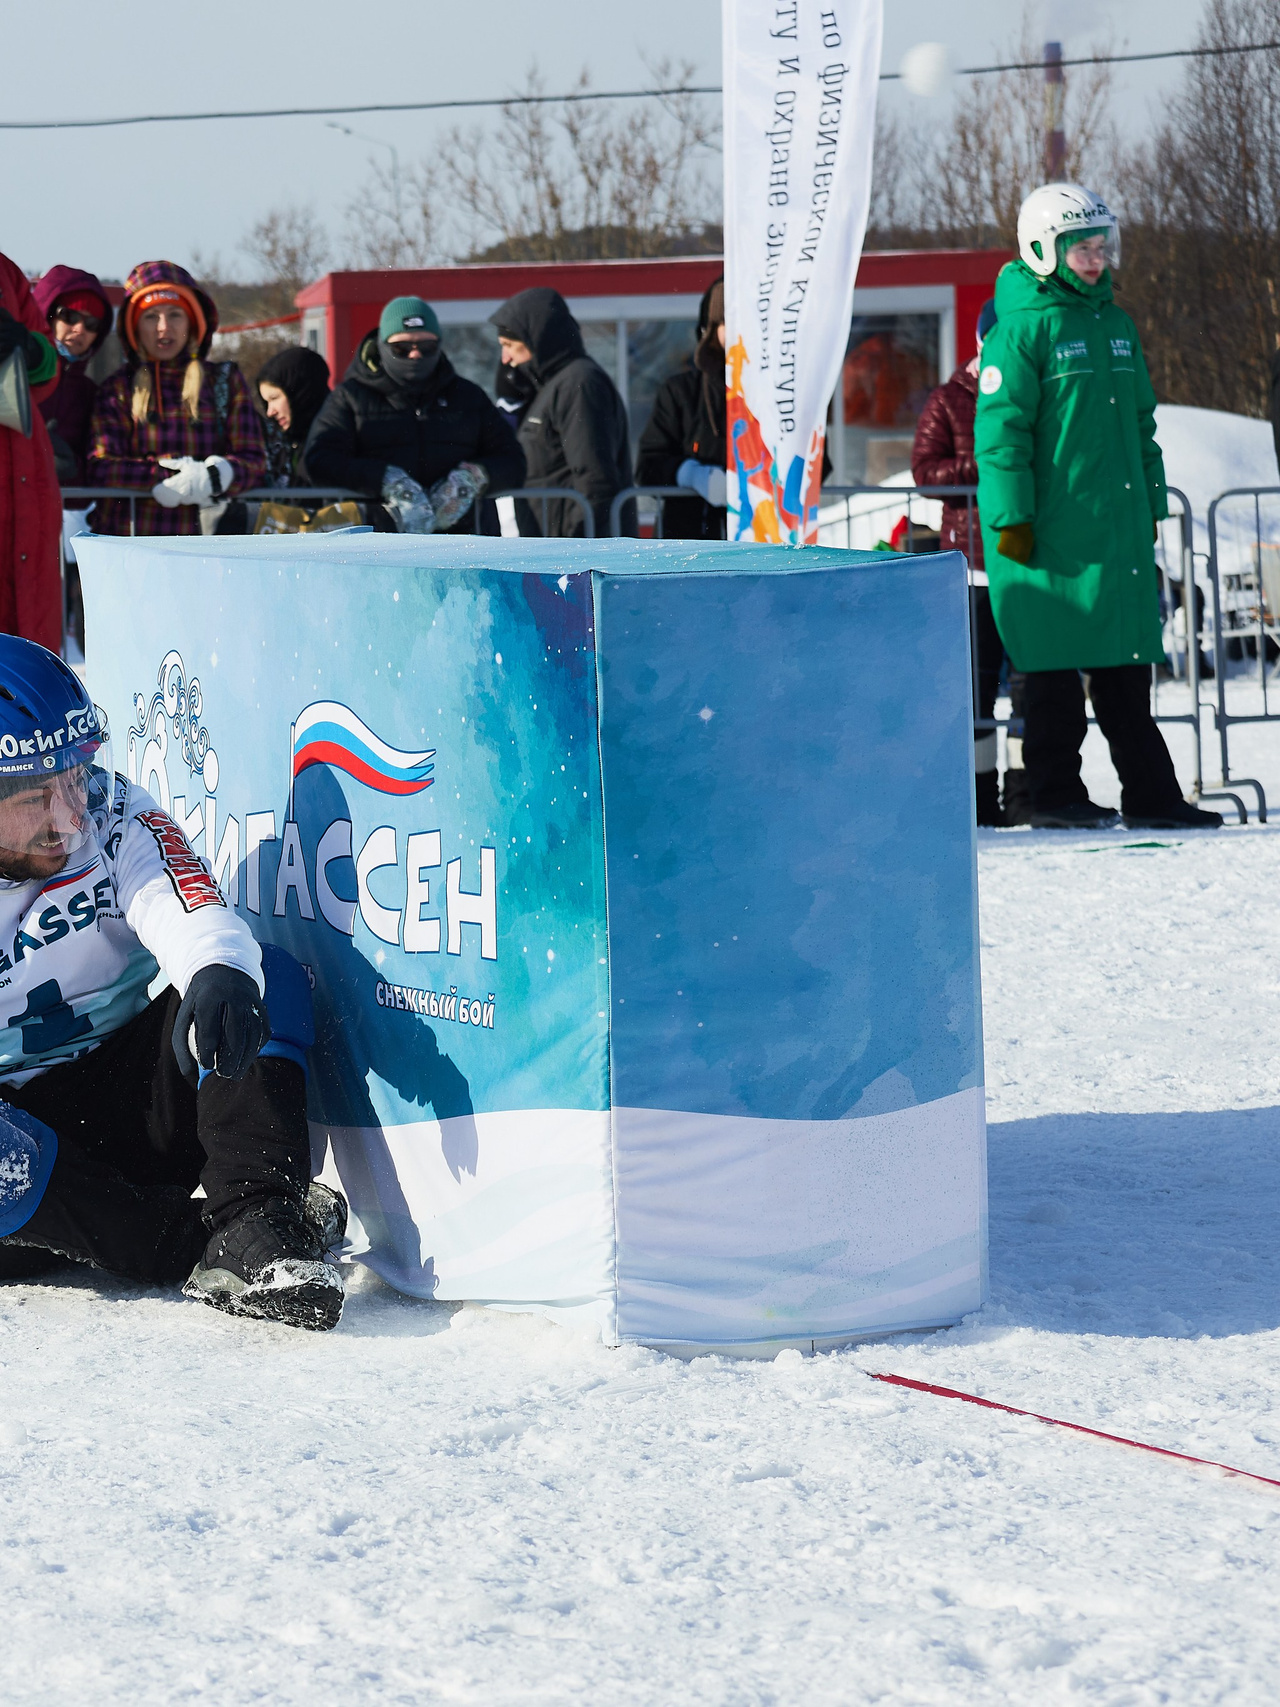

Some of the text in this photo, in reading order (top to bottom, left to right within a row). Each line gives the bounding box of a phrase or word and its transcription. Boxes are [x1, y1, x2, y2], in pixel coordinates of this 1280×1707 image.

[821, 10, 842, 48] по
[777, 56, 800, 77] и
[765, 90, 797, 207] охране
[375, 981, 495, 1029] СНЕЖНЫЙ БОЙ
